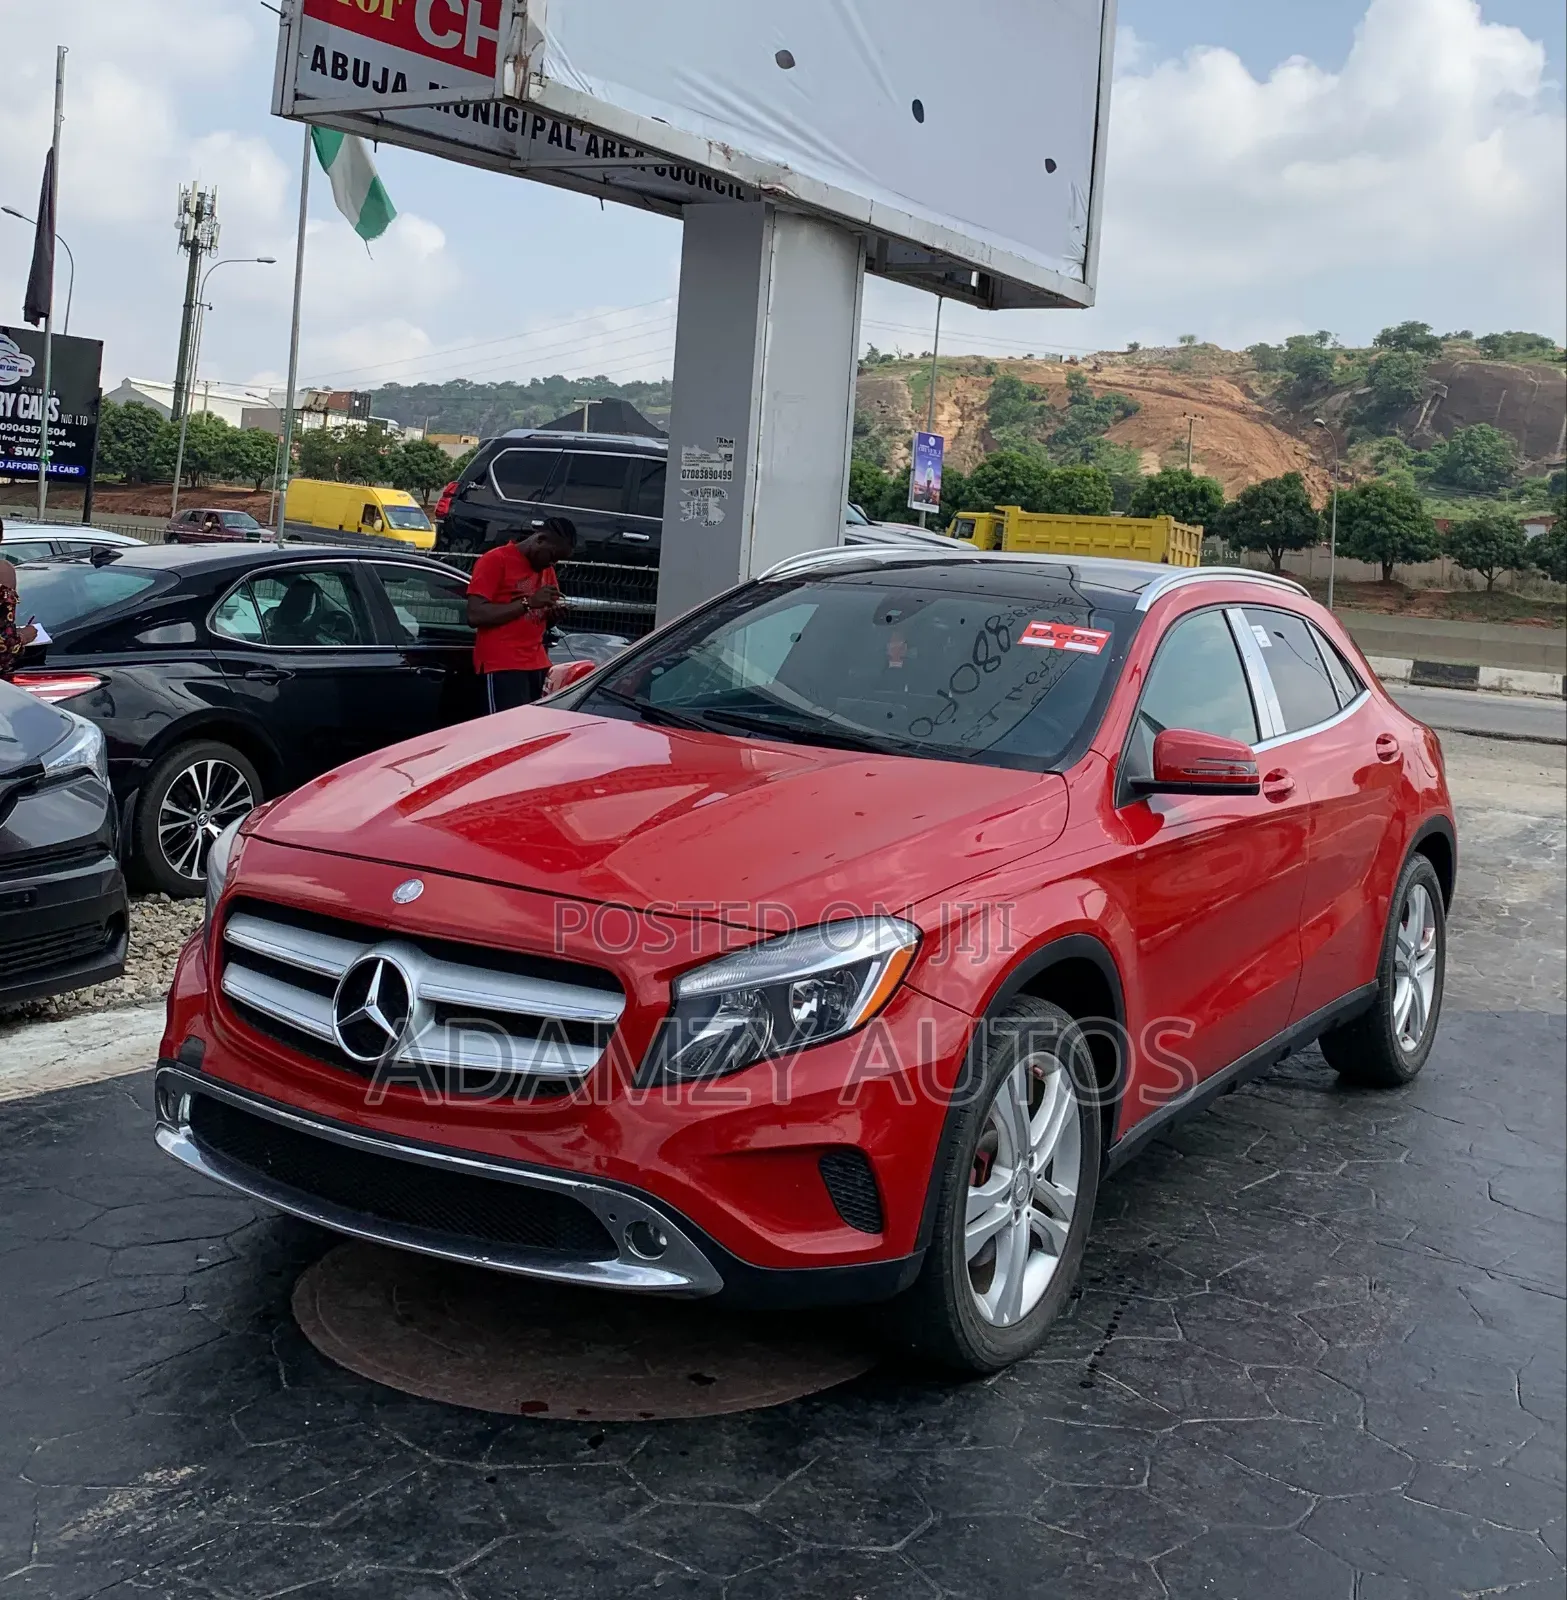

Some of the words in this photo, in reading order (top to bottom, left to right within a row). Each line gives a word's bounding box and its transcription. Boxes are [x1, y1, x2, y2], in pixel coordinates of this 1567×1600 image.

[310, 44, 408, 95] ABUJA
[75, 415, 88, 426] LTD
[0, 422, 67, 437] 0904357504
[58, 465, 80, 475] CARS
[1031, 628, 1099, 644] LAGOS
